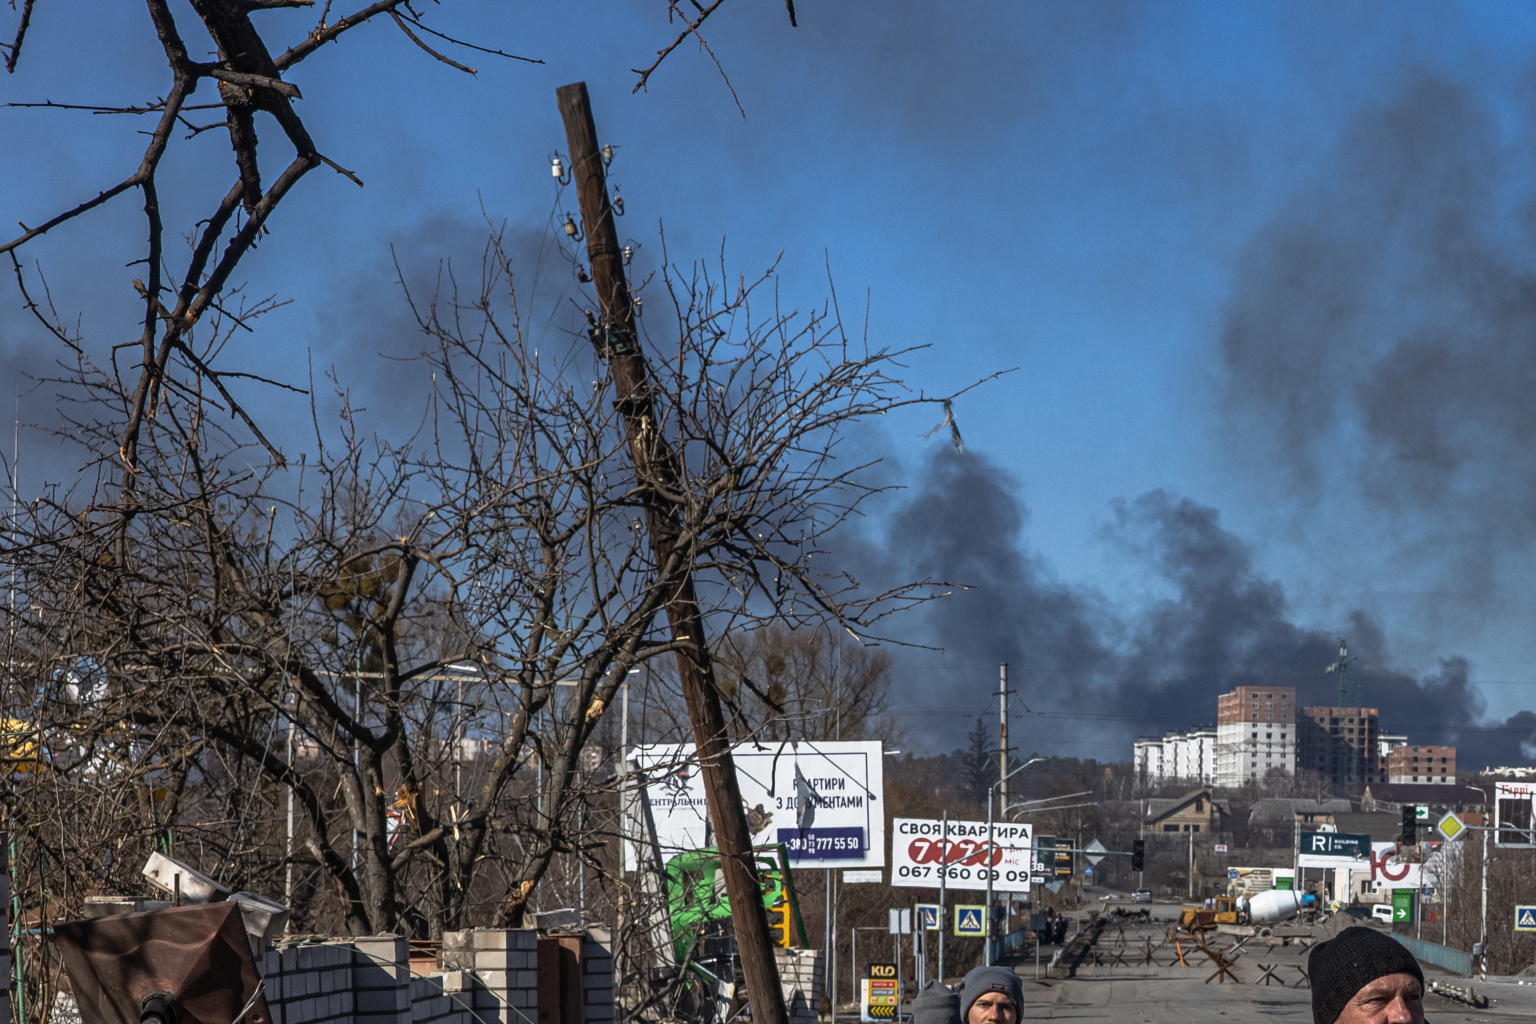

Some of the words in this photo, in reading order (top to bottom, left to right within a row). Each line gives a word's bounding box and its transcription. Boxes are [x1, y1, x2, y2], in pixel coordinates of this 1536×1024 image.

[793, 778, 845, 791] КАРТИРИ
[899, 822, 941, 835] СВОЯ
[816, 838, 833, 850] 777
[834, 838, 846, 850] 55
[847, 837, 859, 850] 50
[898, 866, 932, 878] 067
[937, 868, 971, 880] 960
[976, 869, 1000, 881] 09
[1005, 871, 1029, 883] 09
[871, 965, 896, 977] KLO
